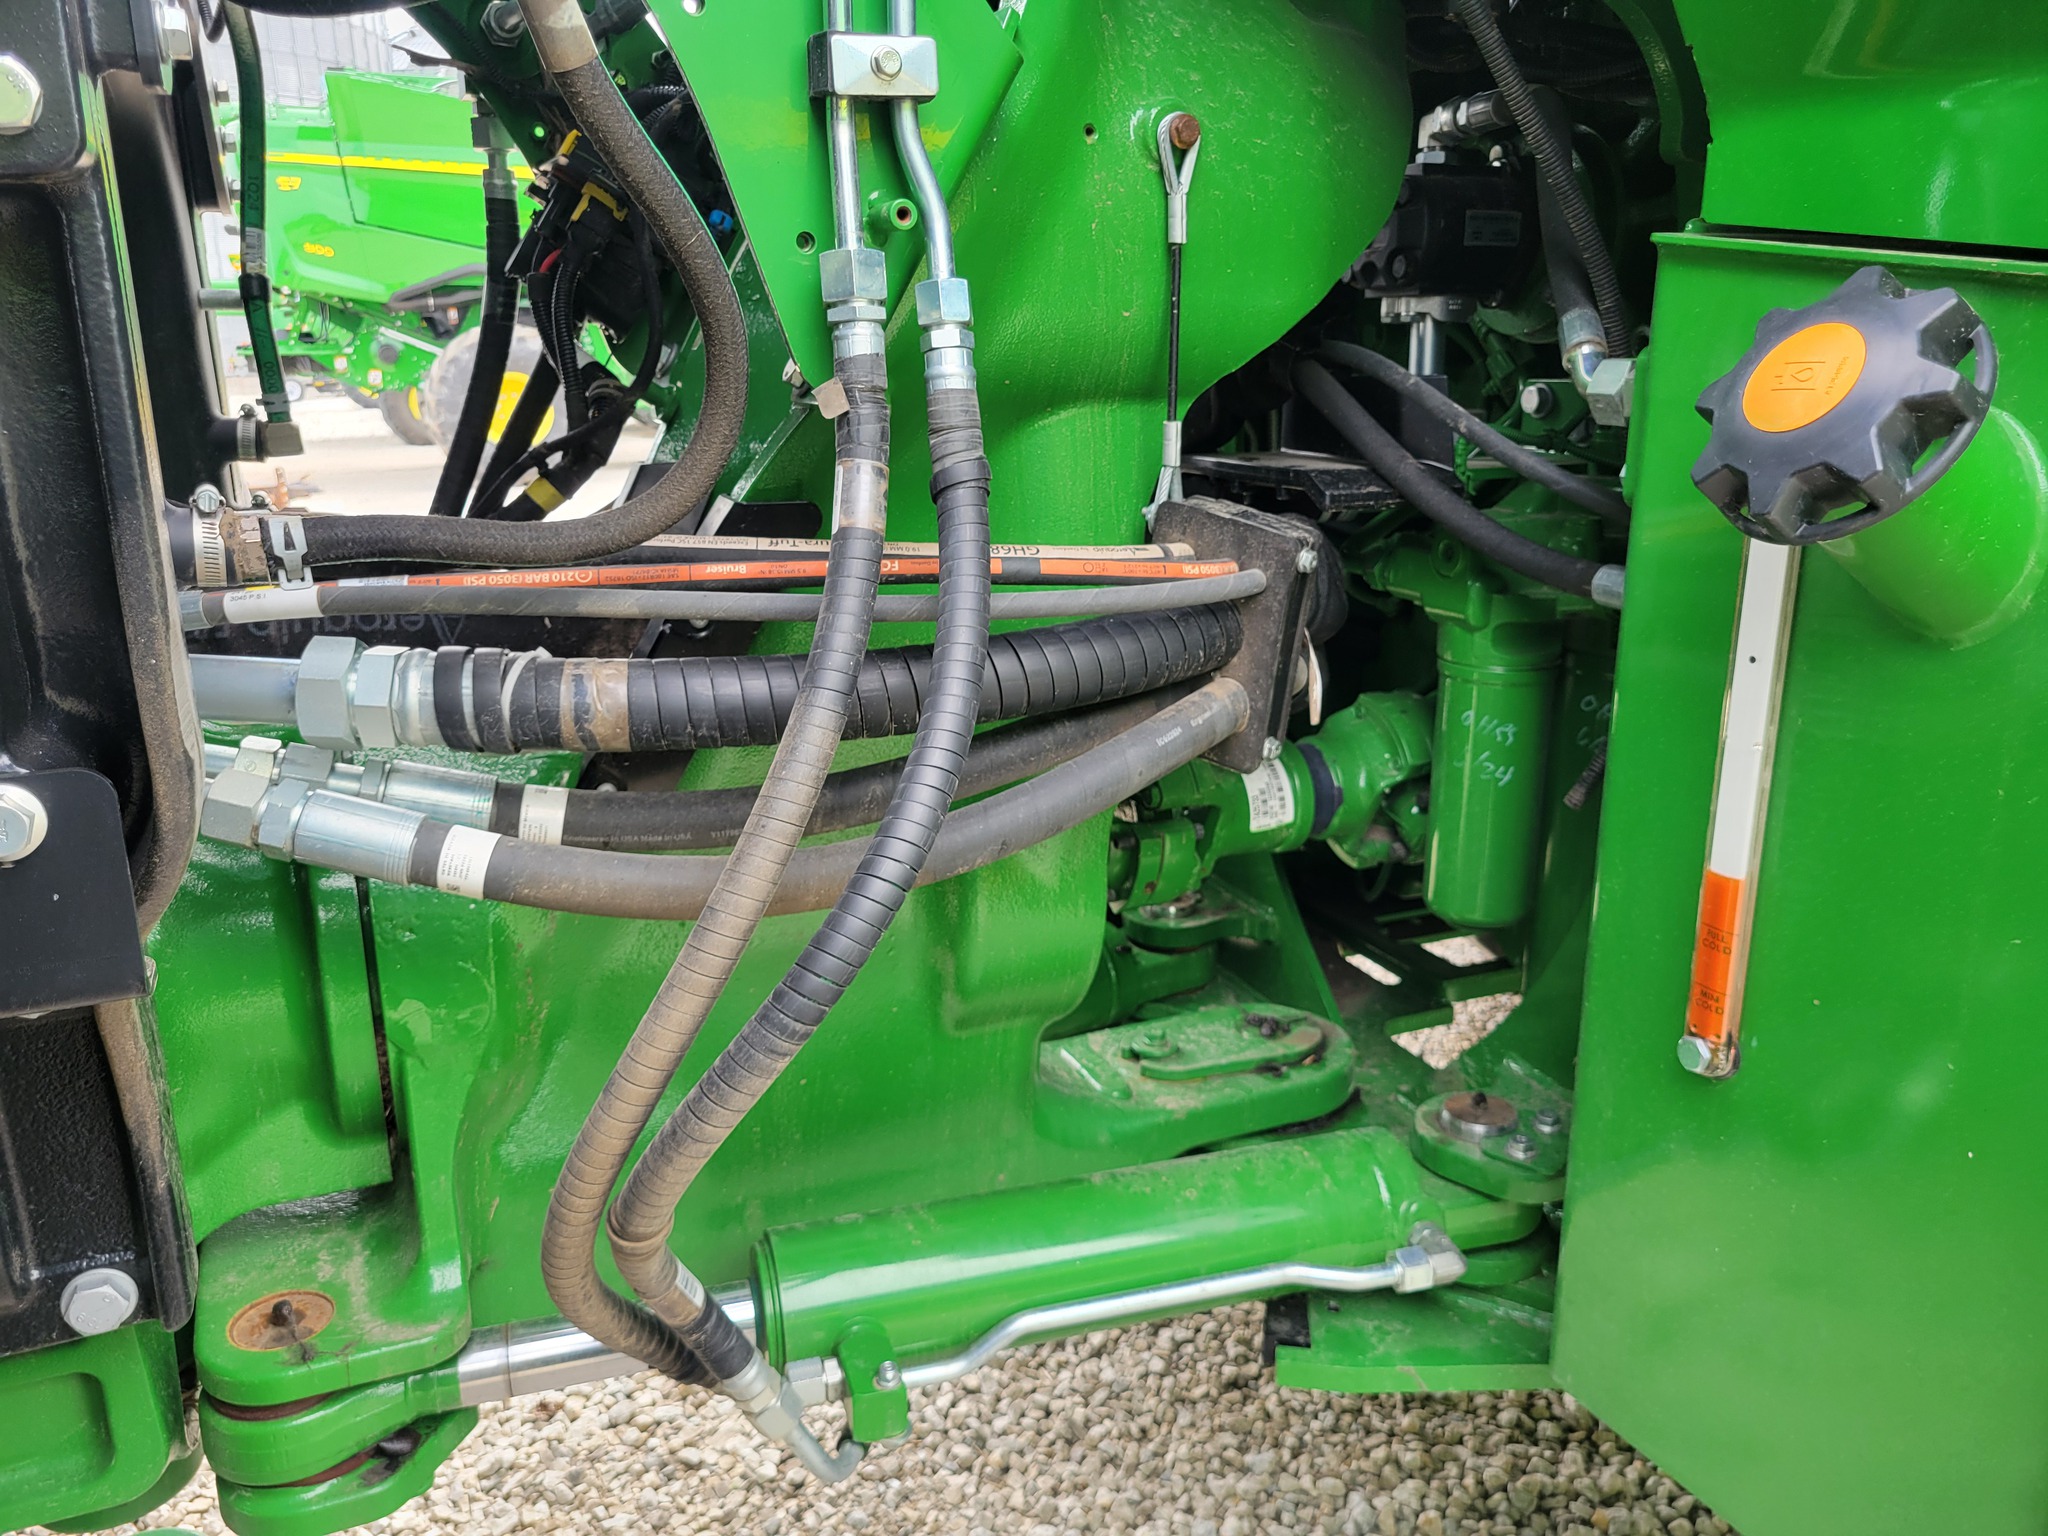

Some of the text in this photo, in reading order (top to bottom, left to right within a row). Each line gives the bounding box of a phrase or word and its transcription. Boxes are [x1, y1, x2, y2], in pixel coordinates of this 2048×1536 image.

[768, 538, 830, 548] ura-Tuff
[705, 564, 747, 574] Bruiser
[881, 559, 899, 571] FC
[462, 572, 574, 586] 210 BAR (3050 PSI)
[1702, 937, 1732, 955] COLD
[1695, 997, 1724, 1015] COLD
